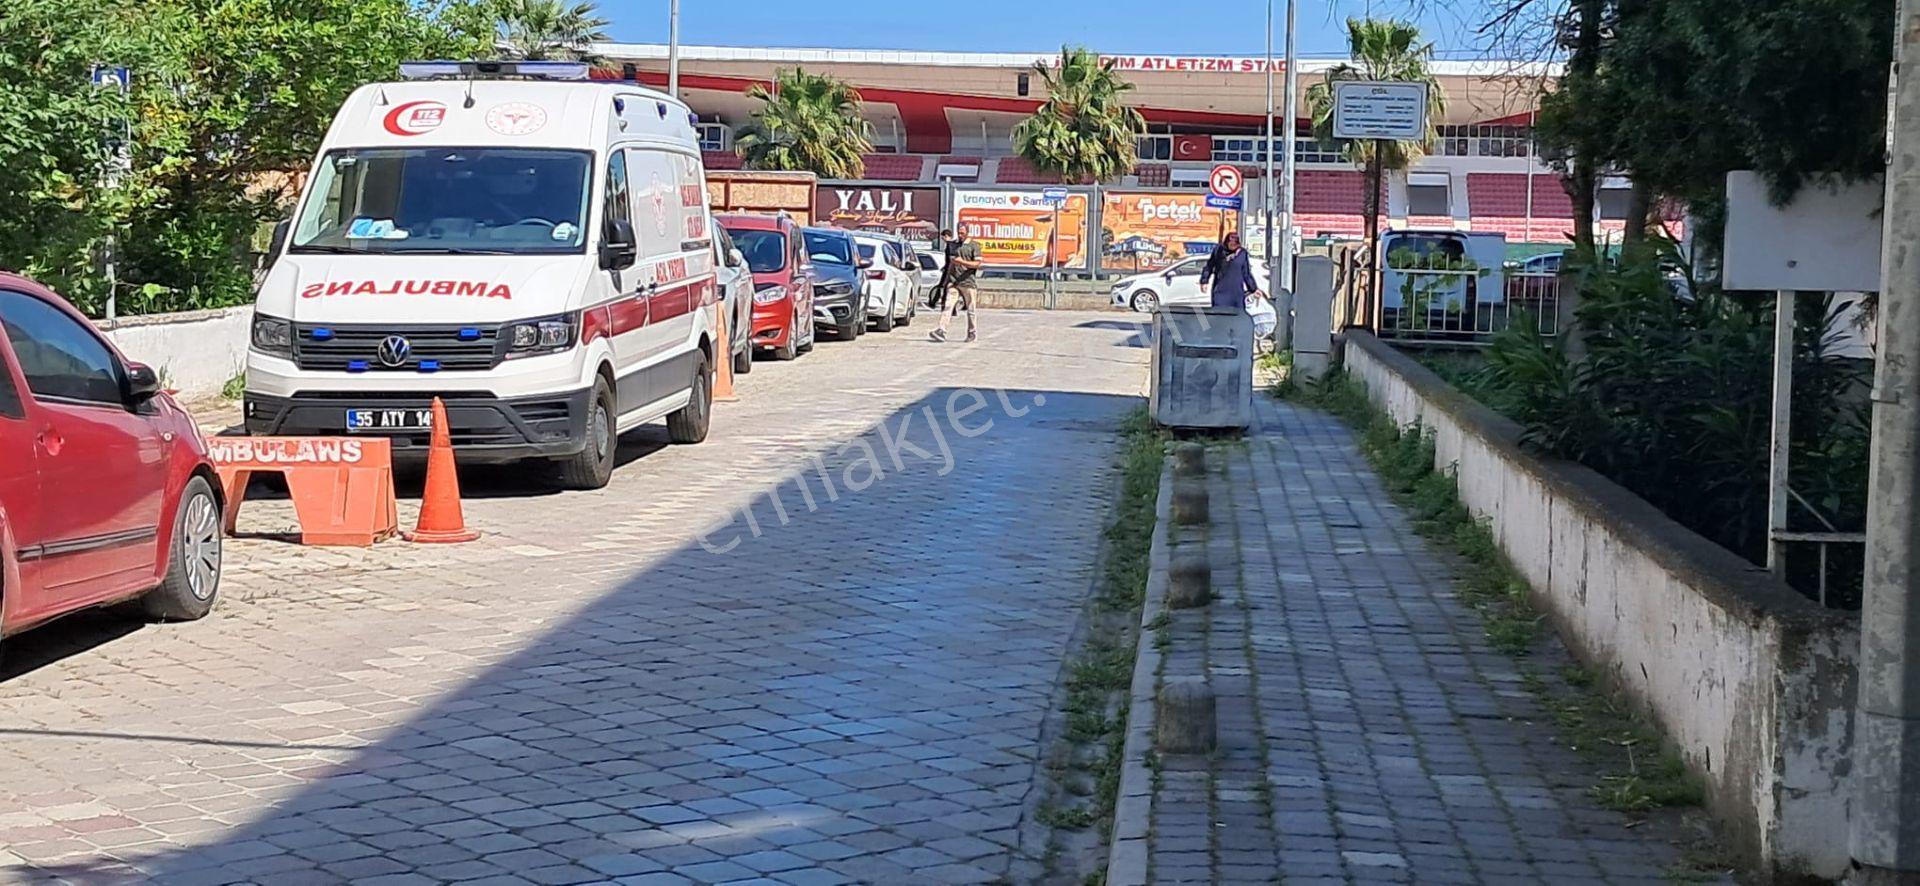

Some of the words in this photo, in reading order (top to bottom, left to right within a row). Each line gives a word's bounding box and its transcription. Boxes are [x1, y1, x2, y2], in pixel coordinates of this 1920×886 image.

[416, 109, 441, 119] 112
[835, 189, 913, 212] YALI
[1139, 199, 1203, 223] petek
[356, 411, 373, 426] 55
[381, 411, 406, 426] ATY
[416, 411, 433, 426] 14
[207, 438, 363, 464] MBULANS
